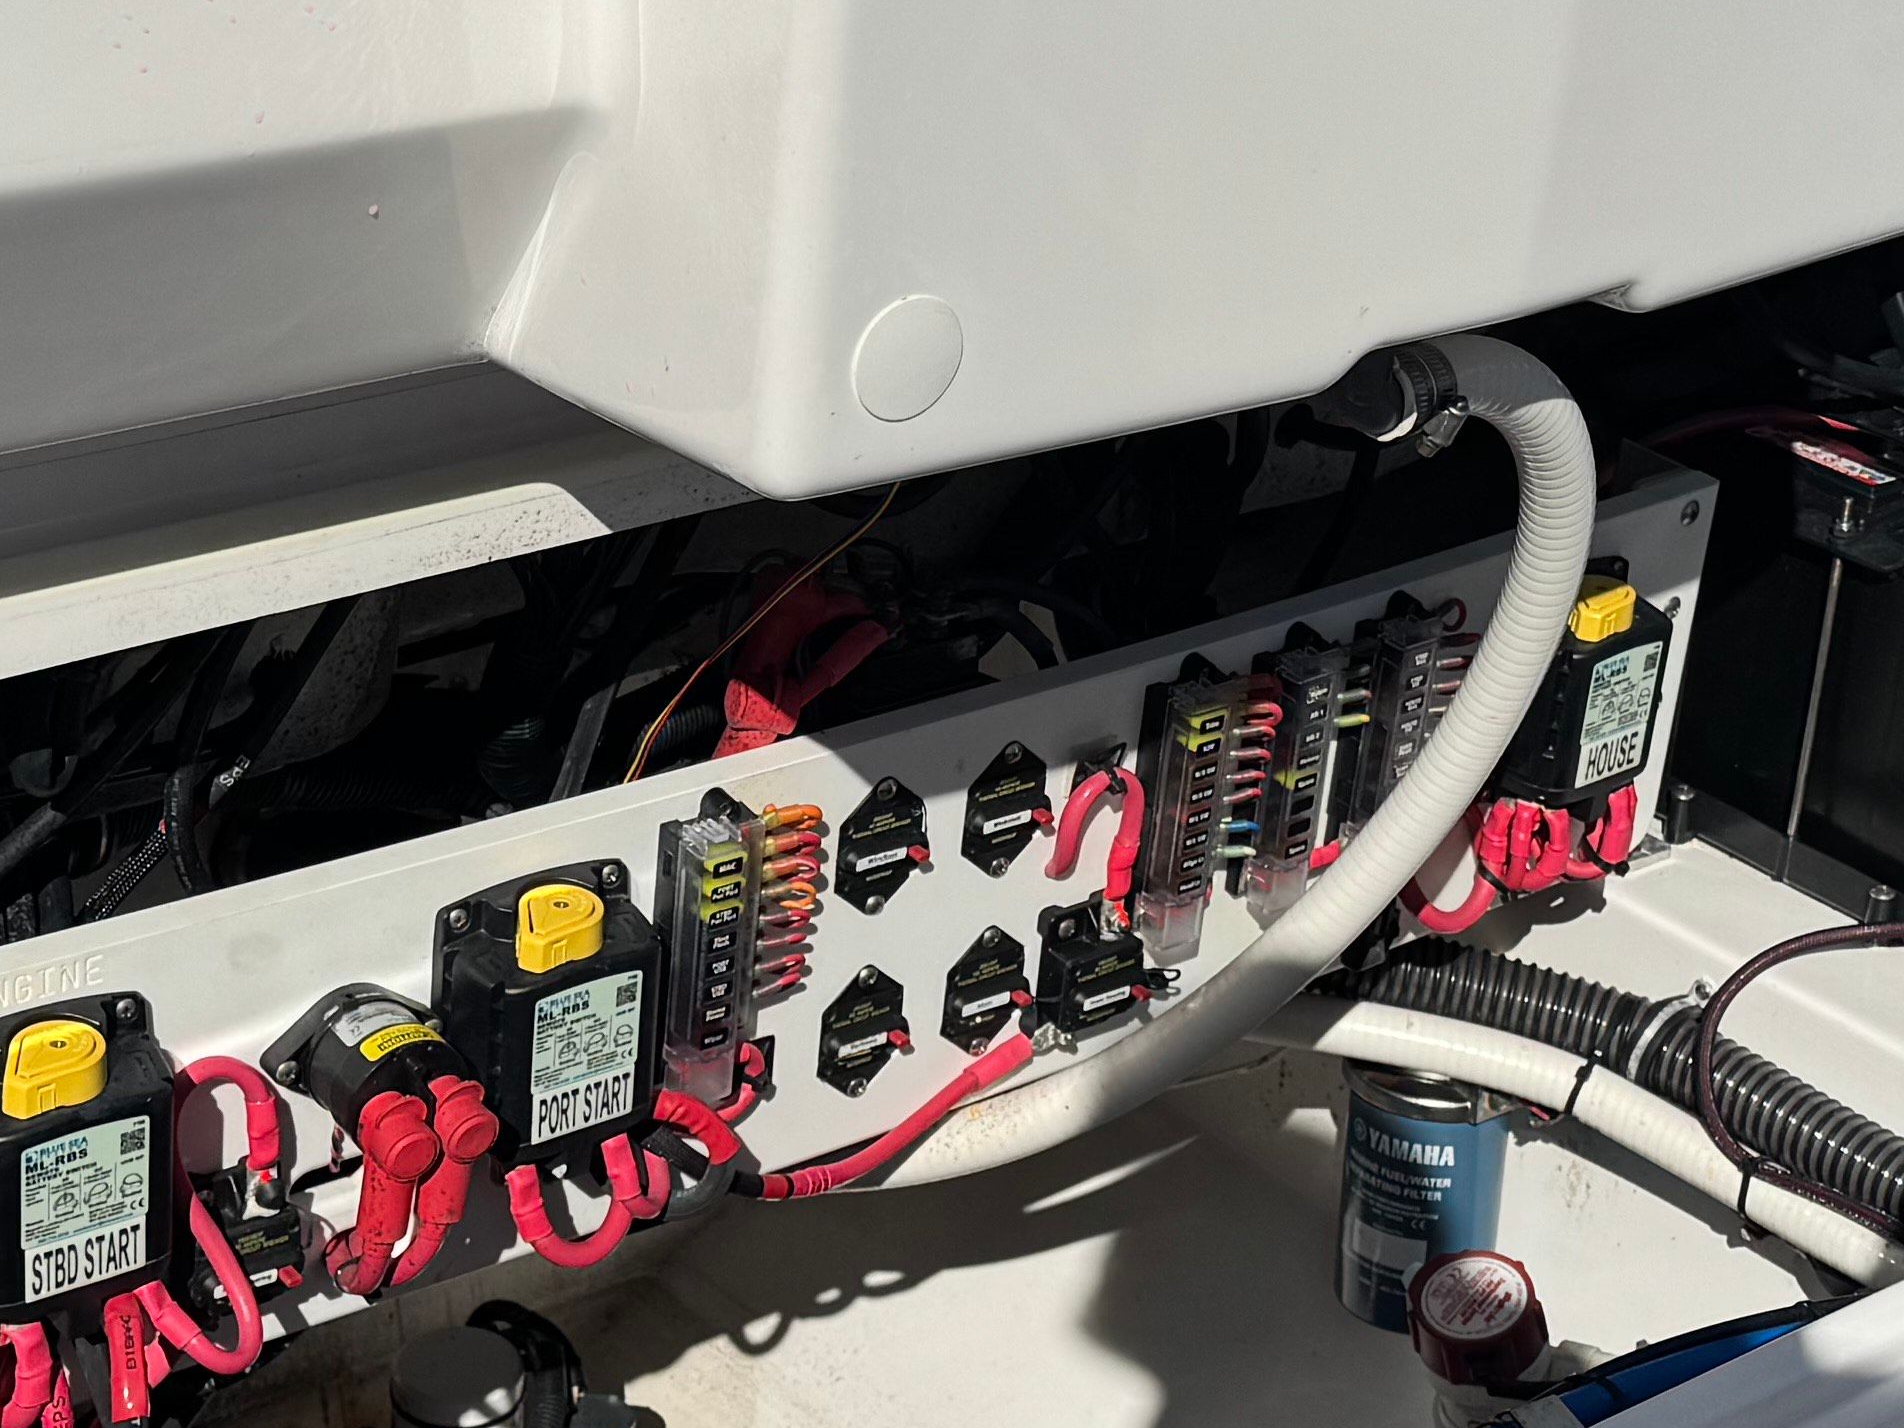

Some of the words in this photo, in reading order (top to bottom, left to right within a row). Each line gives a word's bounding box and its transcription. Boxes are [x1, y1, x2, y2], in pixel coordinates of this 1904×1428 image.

[1585, 731, 1639, 781] HOUSE
[537, 1000, 590, 1025] ML-RBS
[538, 1087, 580, 1139] PORT
[582, 1072, 631, 1124] START
[25, 1148, 89, 1175] ML-RBS
[1367, 1126, 1456, 1167] YAMAHA
[1380, 1164, 1452, 1190] FUEL/WATER
[1403, 1187, 1443, 1203] FILTER
[31, 1243, 79, 1296] STBD
[83, 1224, 141, 1280] START
